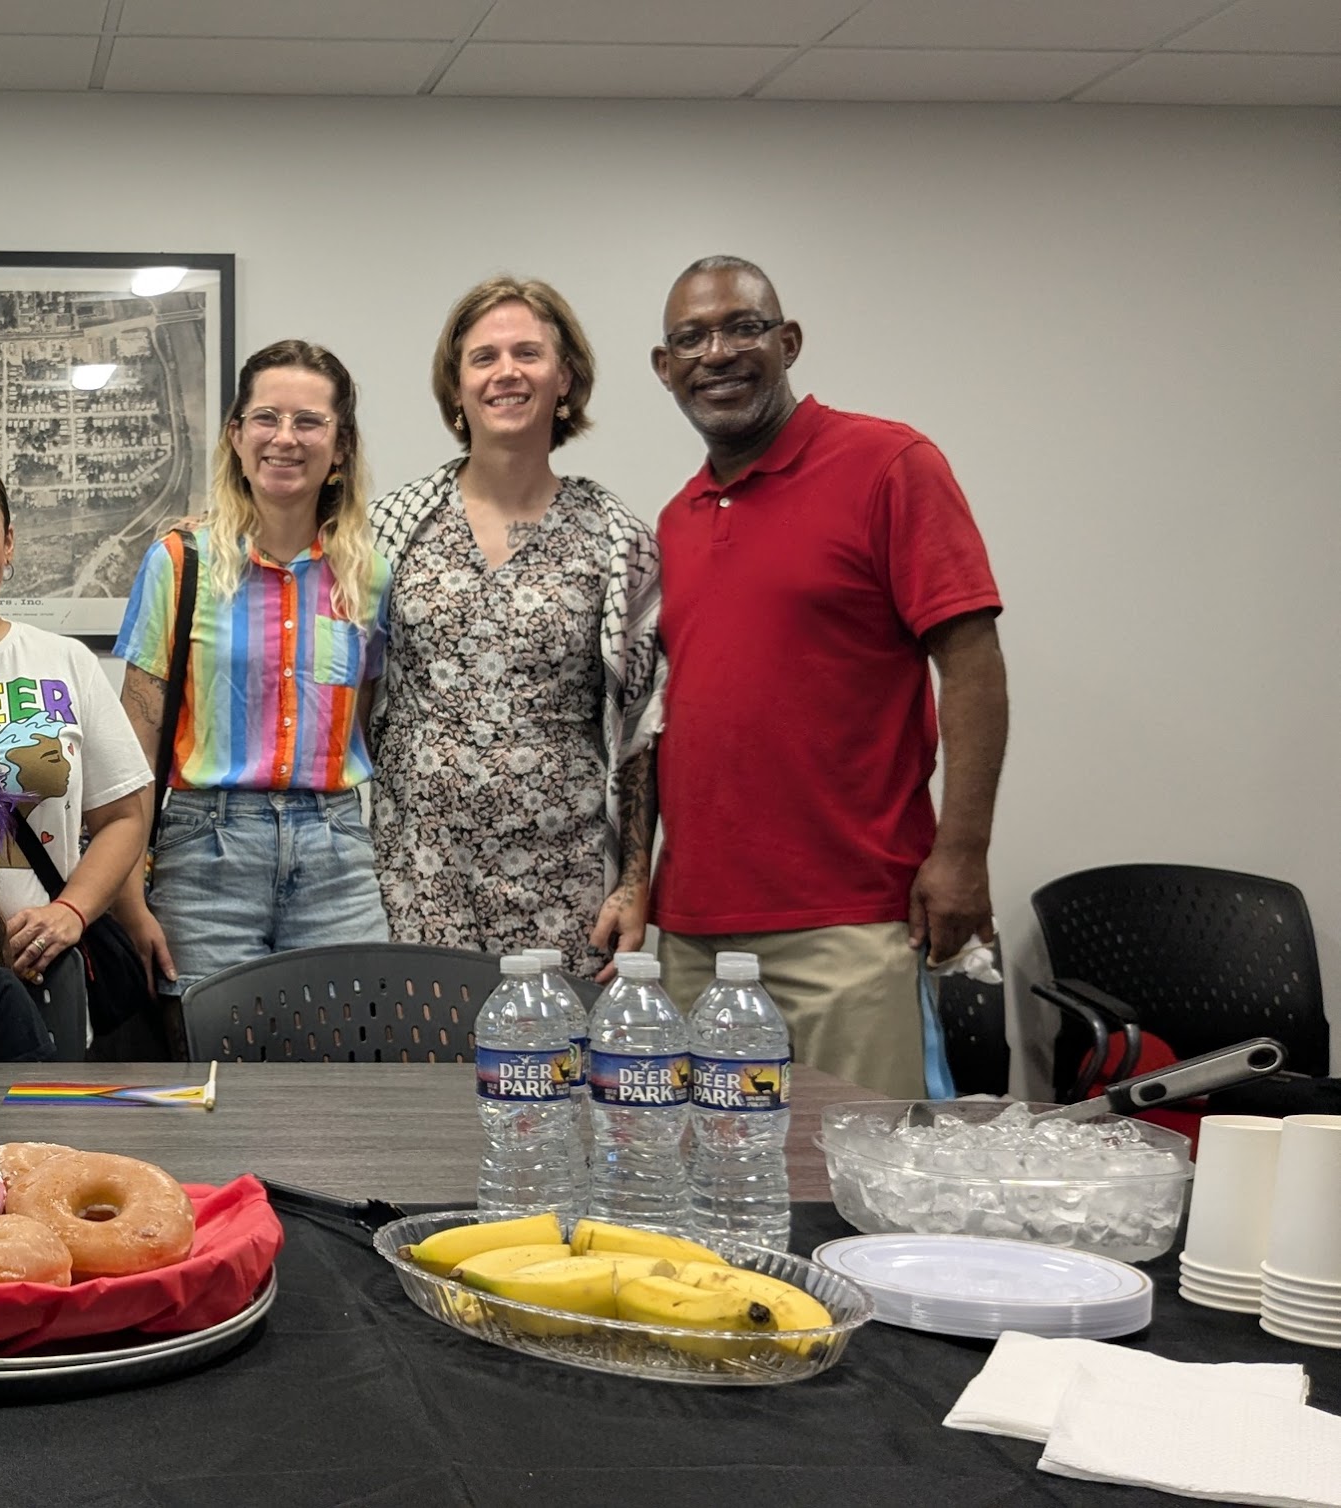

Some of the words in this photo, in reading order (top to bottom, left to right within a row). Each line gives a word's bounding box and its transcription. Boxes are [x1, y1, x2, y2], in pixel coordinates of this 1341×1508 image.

[499, 1063, 552, 1079] DEER
[618, 1068, 672, 1085] DEER
[693, 1069, 741, 1089] DEER
[499, 1079, 554, 1098] PARK
[619, 1085, 674, 1104] PARK
[693, 1086, 743, 1108] PARK
